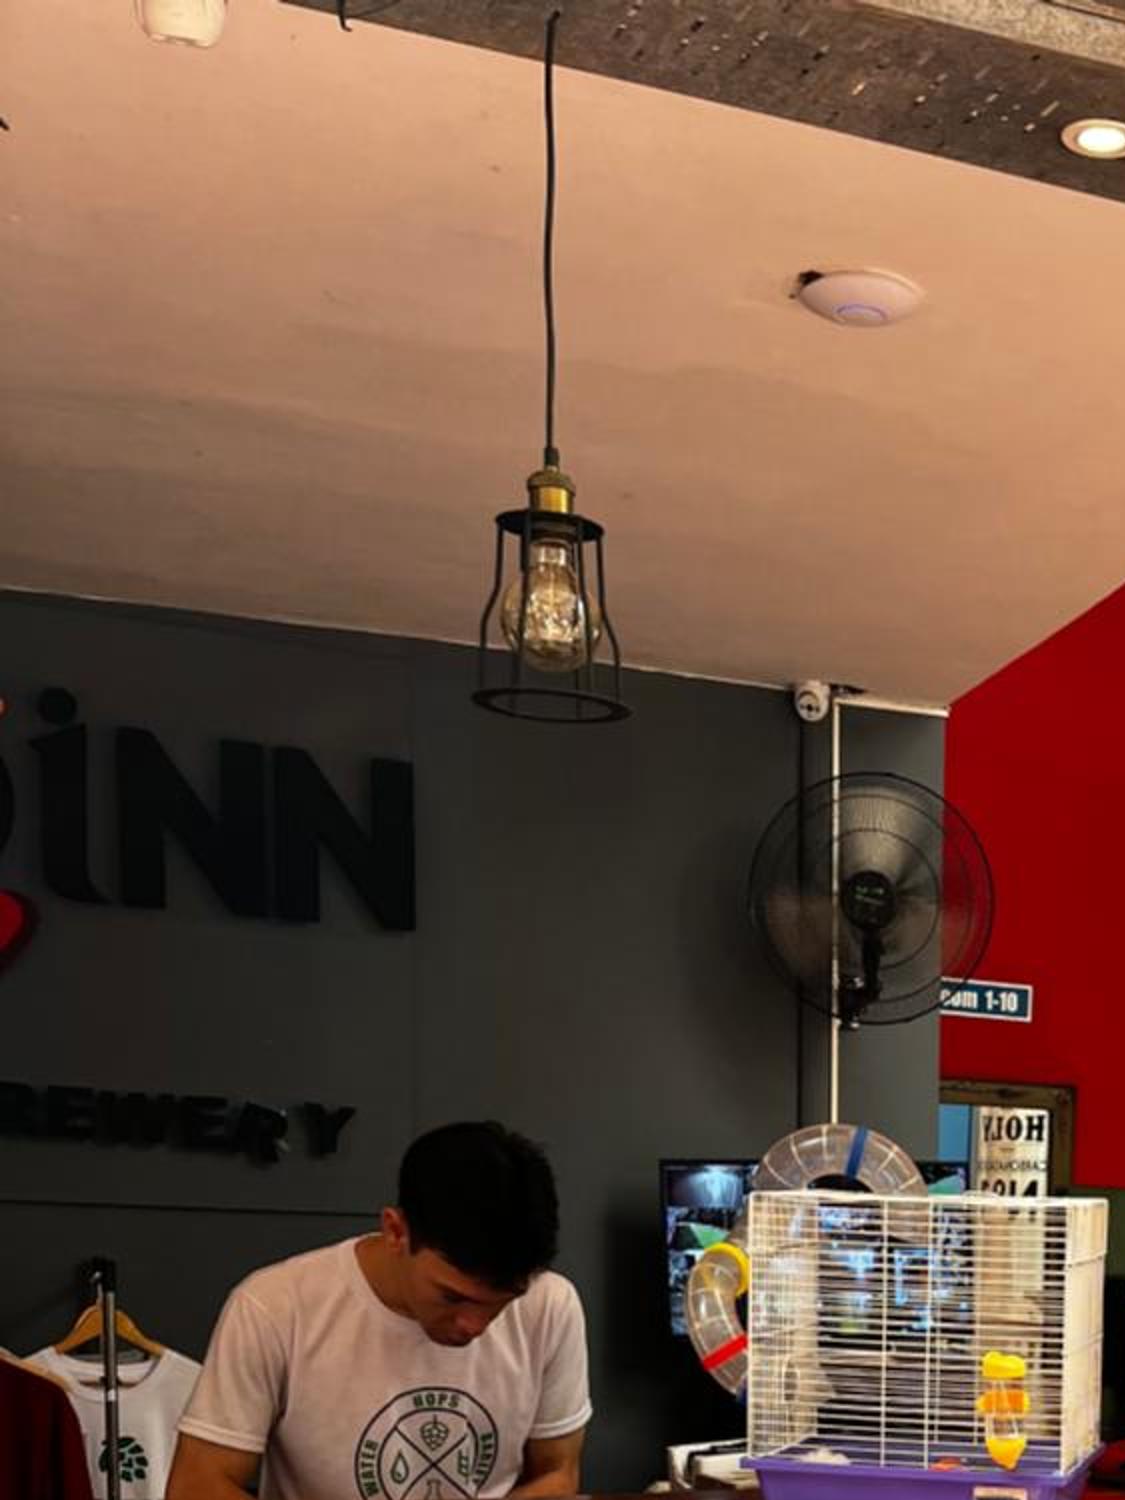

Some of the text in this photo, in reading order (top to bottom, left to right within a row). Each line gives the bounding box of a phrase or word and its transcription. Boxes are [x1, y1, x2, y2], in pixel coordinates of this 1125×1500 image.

[984, 990, 1019, 1013] 1-10
[412, 1392, 462, 1409] HOPS
[361, 1438, 379, 1497] WATER
